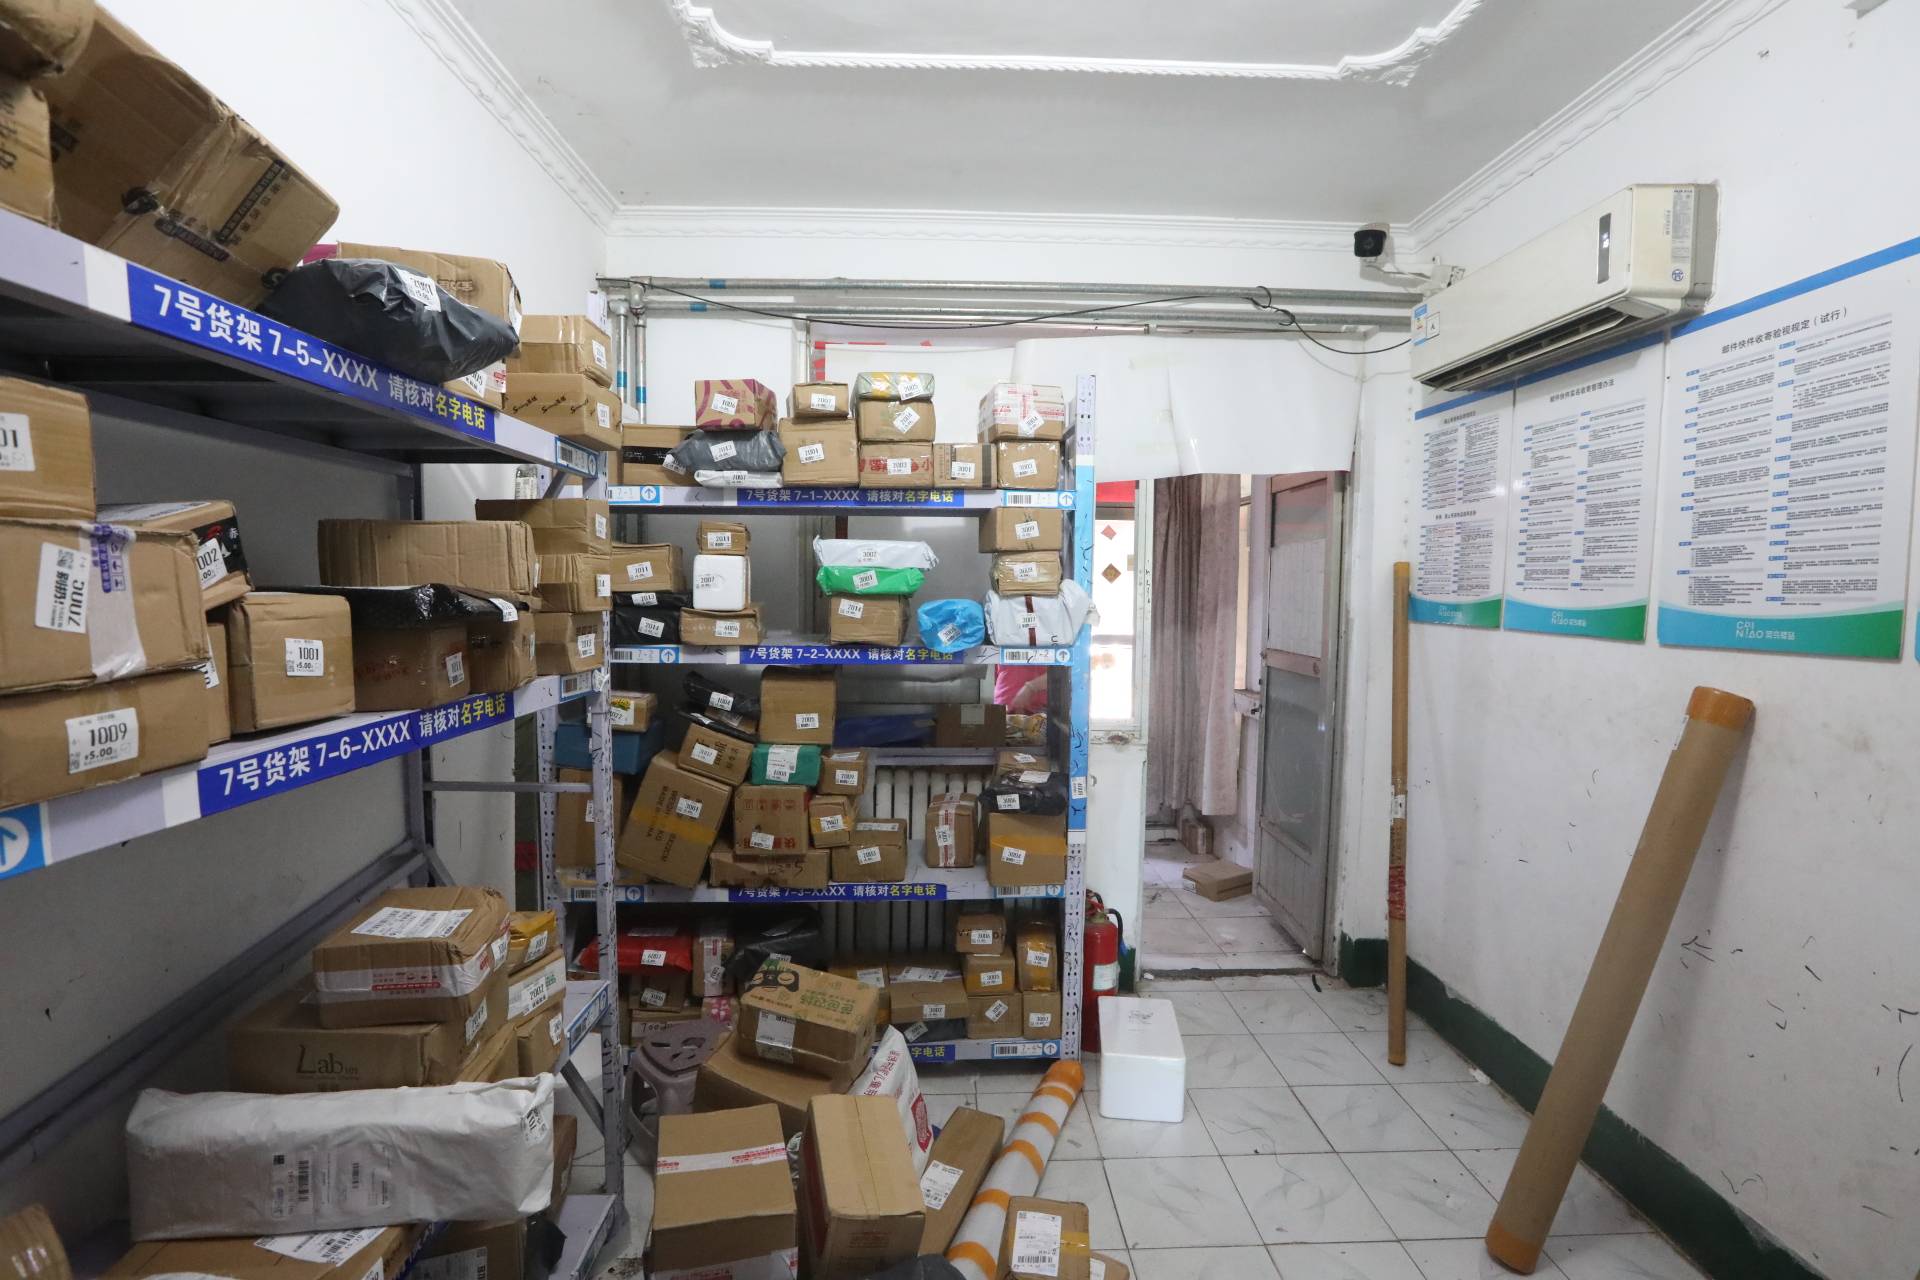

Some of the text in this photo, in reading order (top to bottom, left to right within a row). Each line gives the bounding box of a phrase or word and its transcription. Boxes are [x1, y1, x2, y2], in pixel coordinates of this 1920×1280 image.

[154, 285, 486, 431] 7号货架 7-5-XXXX 请核对名字电话
[746, 489, 954, 502] 7号货架 7-1-XXXX 请核对名字电话
[197, 546, 220, 571] 002
[299, 646, 319, 661] 1001
[749, 647, 954, 661] 7号货架 7-2-XXXX 请核对名字电话
[89, 722, 127, 747] 1009
[219, 693, 506, 796] 7号货架 7-6-XXXX 请核对名字电话
[853, 883, 937, 897] 请核对名字电话
[911, 1046, 945, 1058] 字电话
